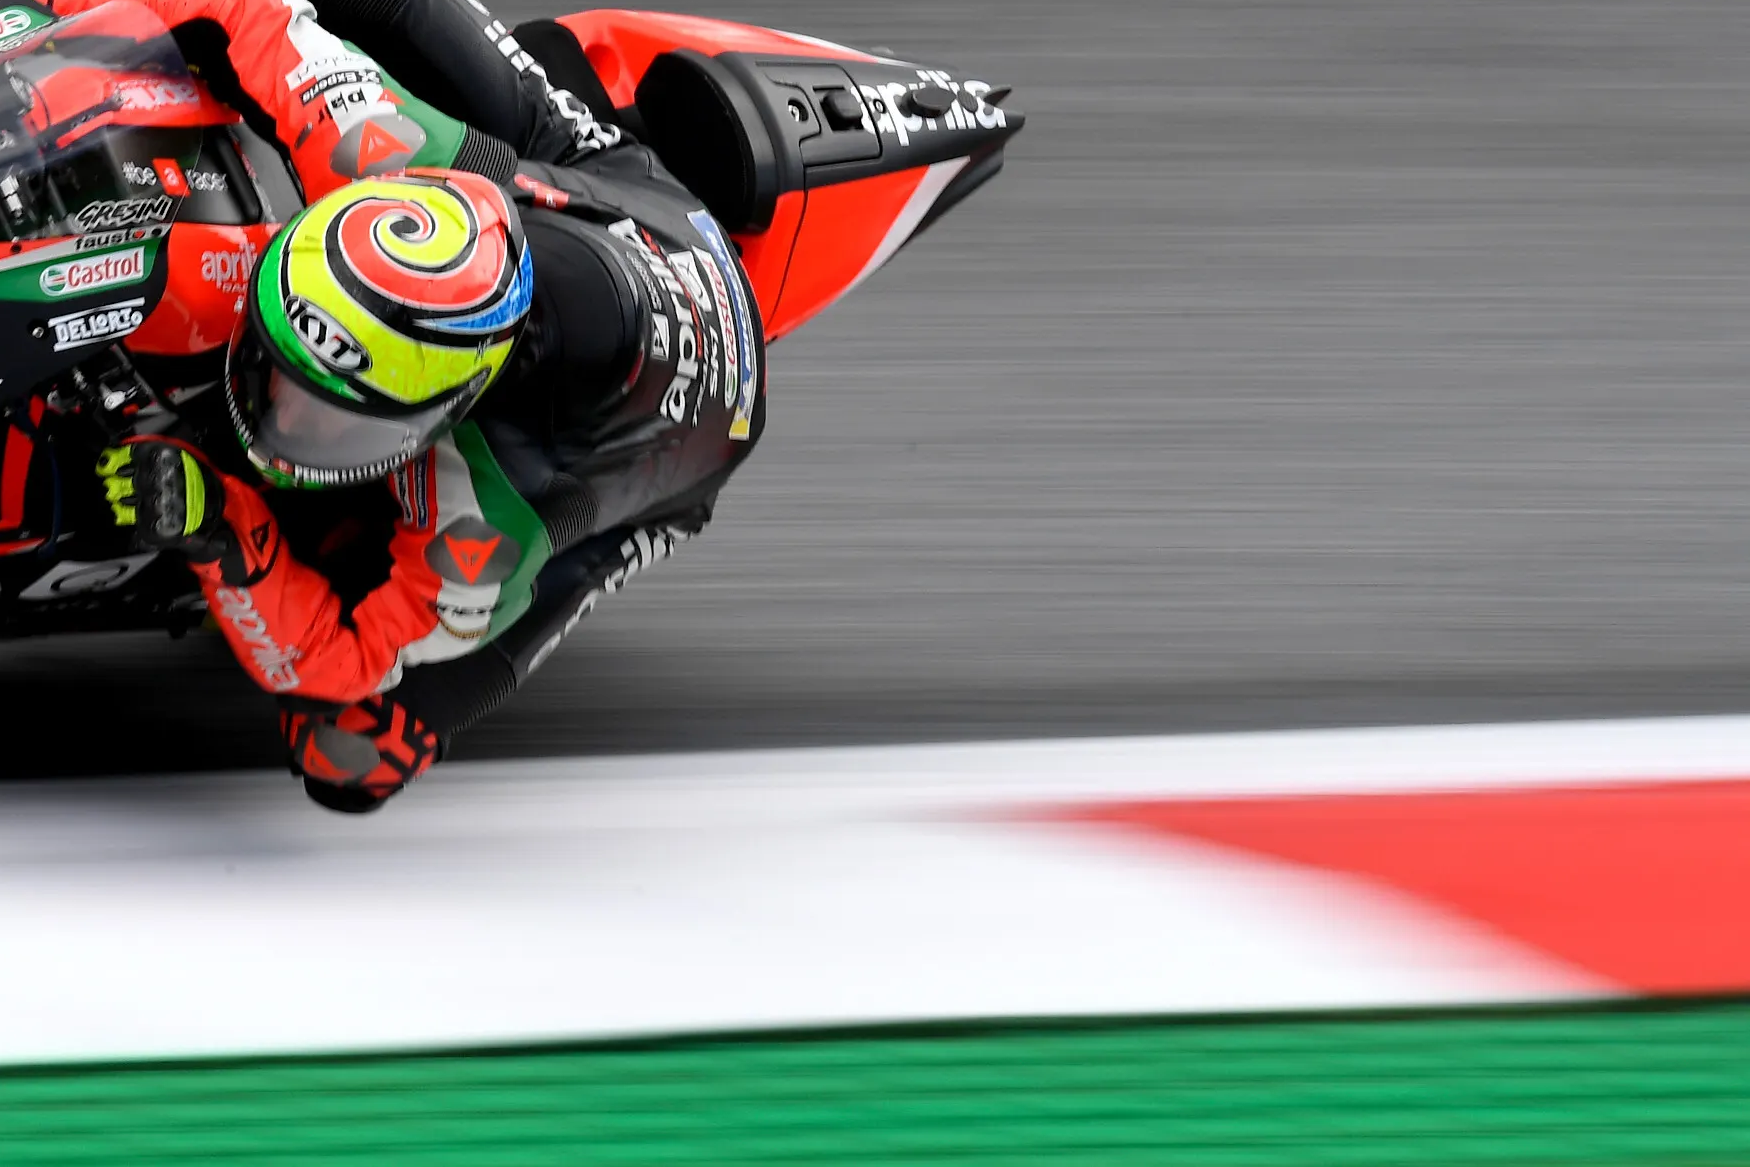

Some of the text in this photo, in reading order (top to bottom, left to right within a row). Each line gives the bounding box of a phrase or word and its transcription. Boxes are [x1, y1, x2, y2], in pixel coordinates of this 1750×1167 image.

[75, 194, 173, 232] GRESINI
[67, 251, 142, 288] Castrol
[200, 241, 257, 290] aprili
[286, 297, 362, 360] KYT
